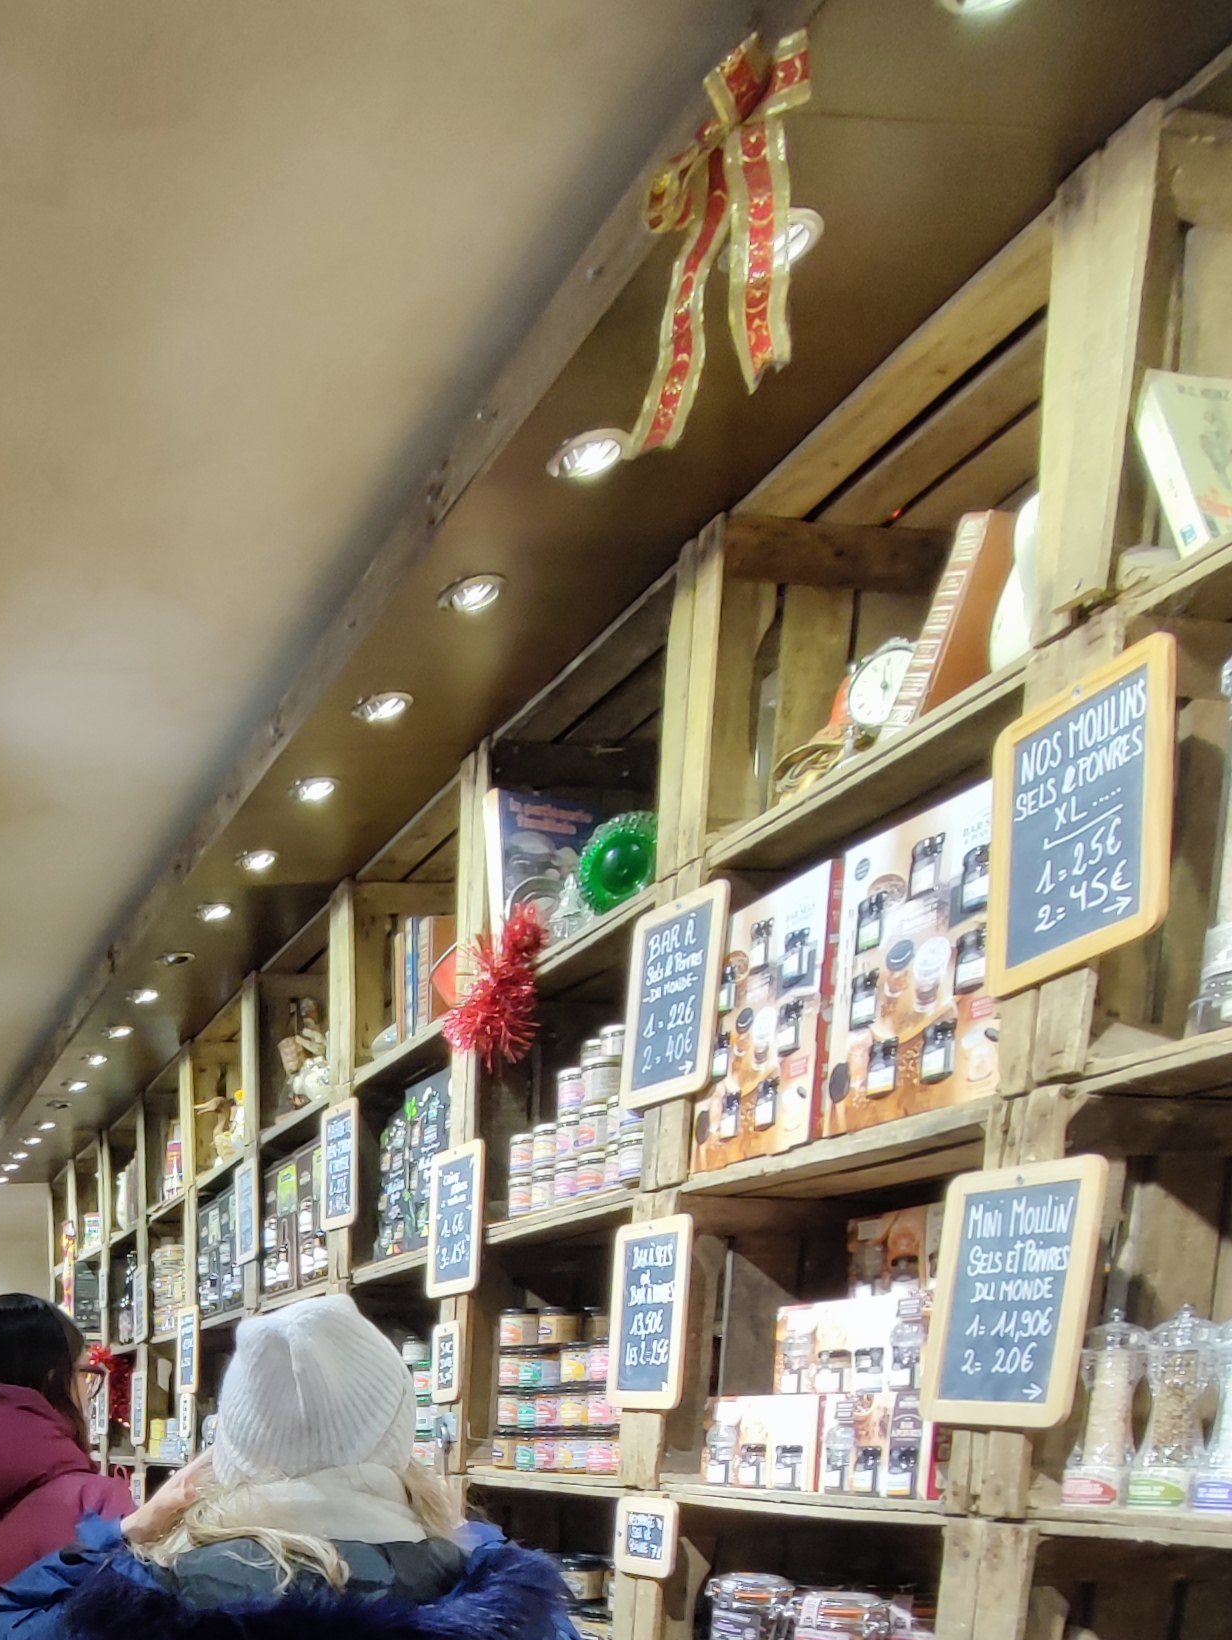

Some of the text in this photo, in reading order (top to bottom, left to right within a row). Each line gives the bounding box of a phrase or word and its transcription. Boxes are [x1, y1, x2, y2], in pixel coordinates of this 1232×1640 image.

[1021, 679, 1147, 786] NOS MOULINS
[1014, 777, 1057, 822] SELS
[1077, 725, 1143, 787] POIVRES
[647, 924, 681, 966] BAR
[970, 1276, 1055, 1303] DU MONDE
[991, 1342, 1038, 1374] 20€
